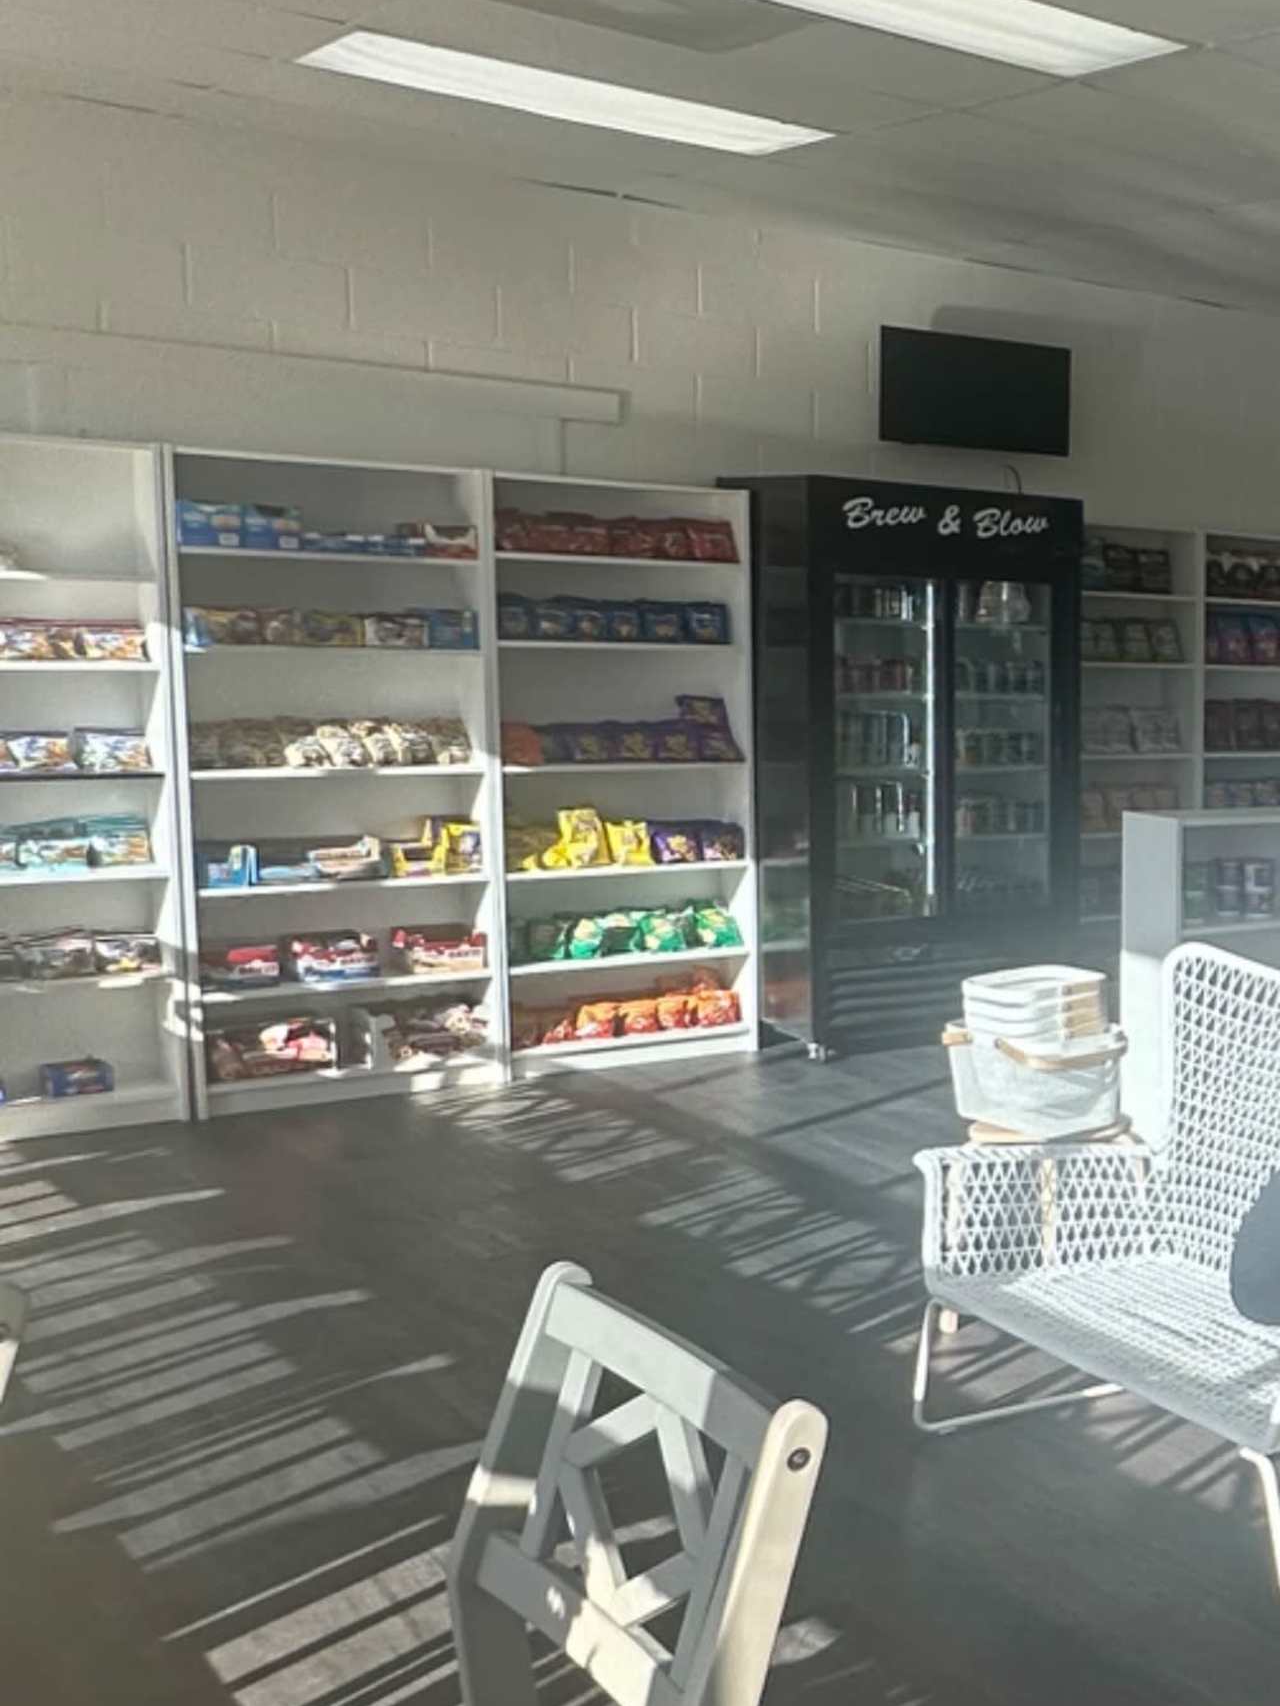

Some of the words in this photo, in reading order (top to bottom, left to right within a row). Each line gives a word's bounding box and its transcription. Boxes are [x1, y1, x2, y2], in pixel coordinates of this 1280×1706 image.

[842, 497, 927, 529] Brew
[937, 505, 961, 536] &
[973, 508, 1049, 538] Blow
